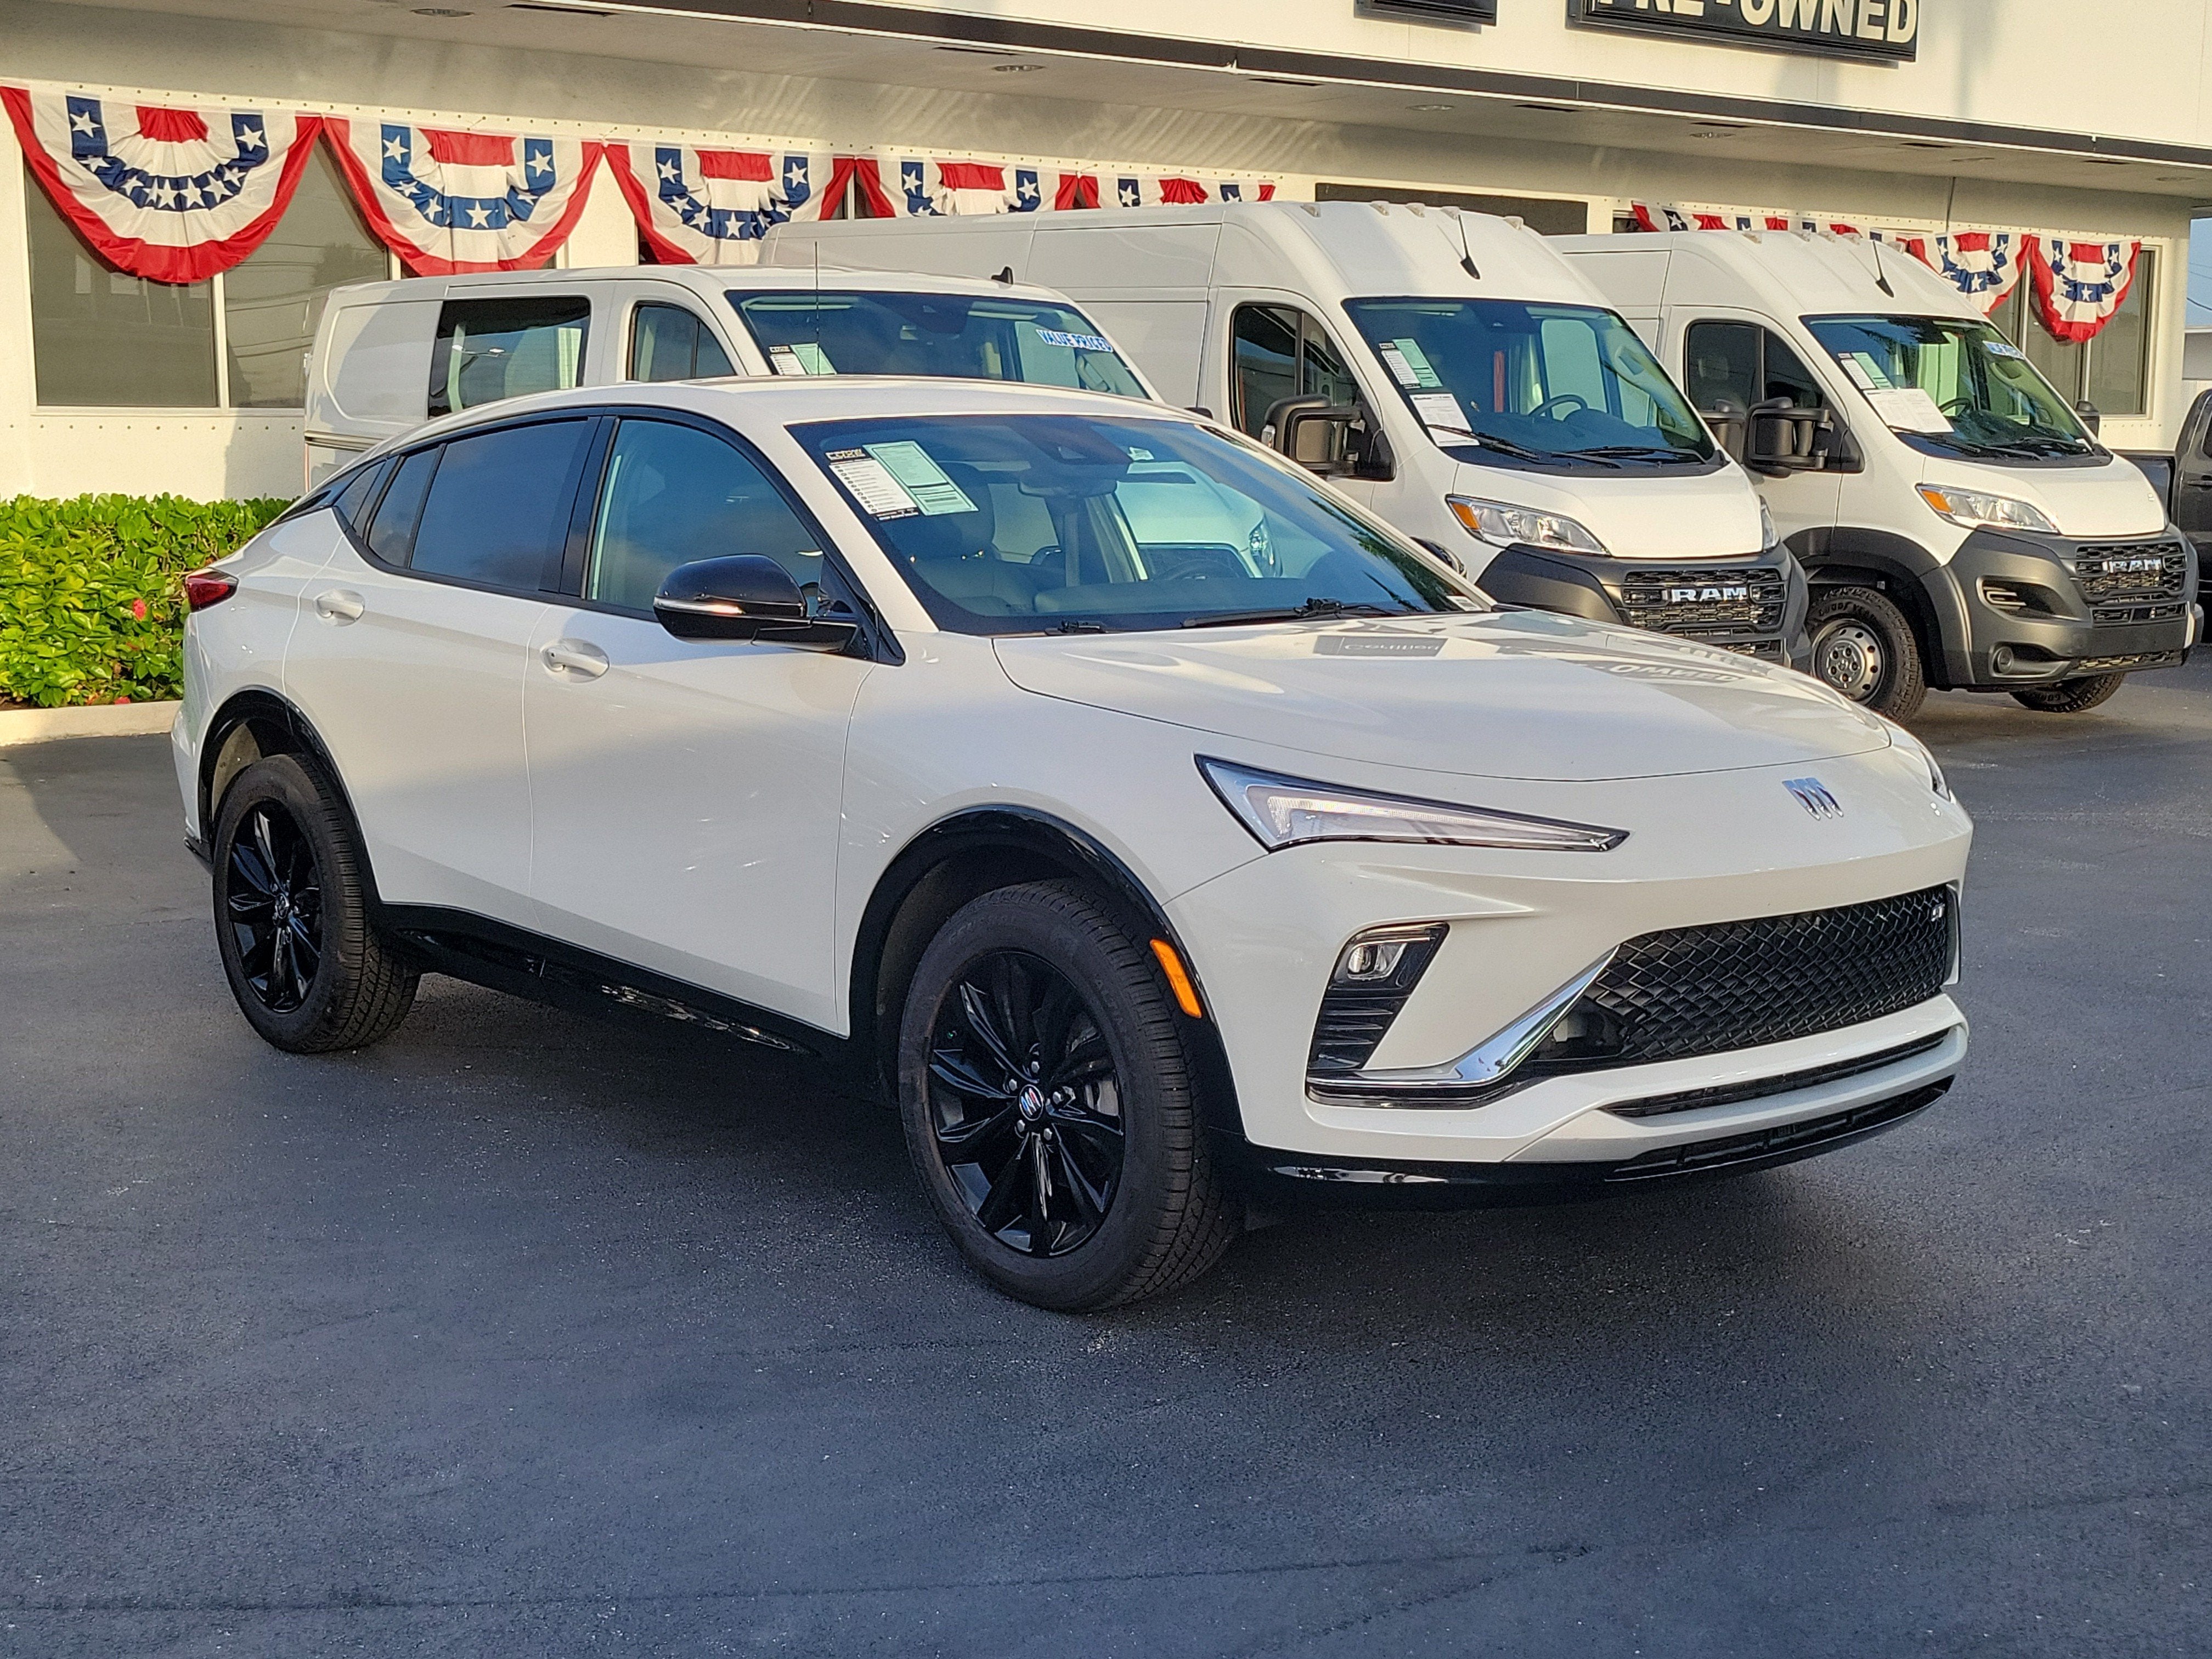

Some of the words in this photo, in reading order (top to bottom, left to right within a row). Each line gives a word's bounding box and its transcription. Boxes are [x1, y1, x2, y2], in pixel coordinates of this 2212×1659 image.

[1599, 0, 1917, 44] -OWNED
[1039, 330, 1074, 346] VALUE
[2109, 558, 2162, 573] RAM
[1672, 586, 1747, 602] RAM
